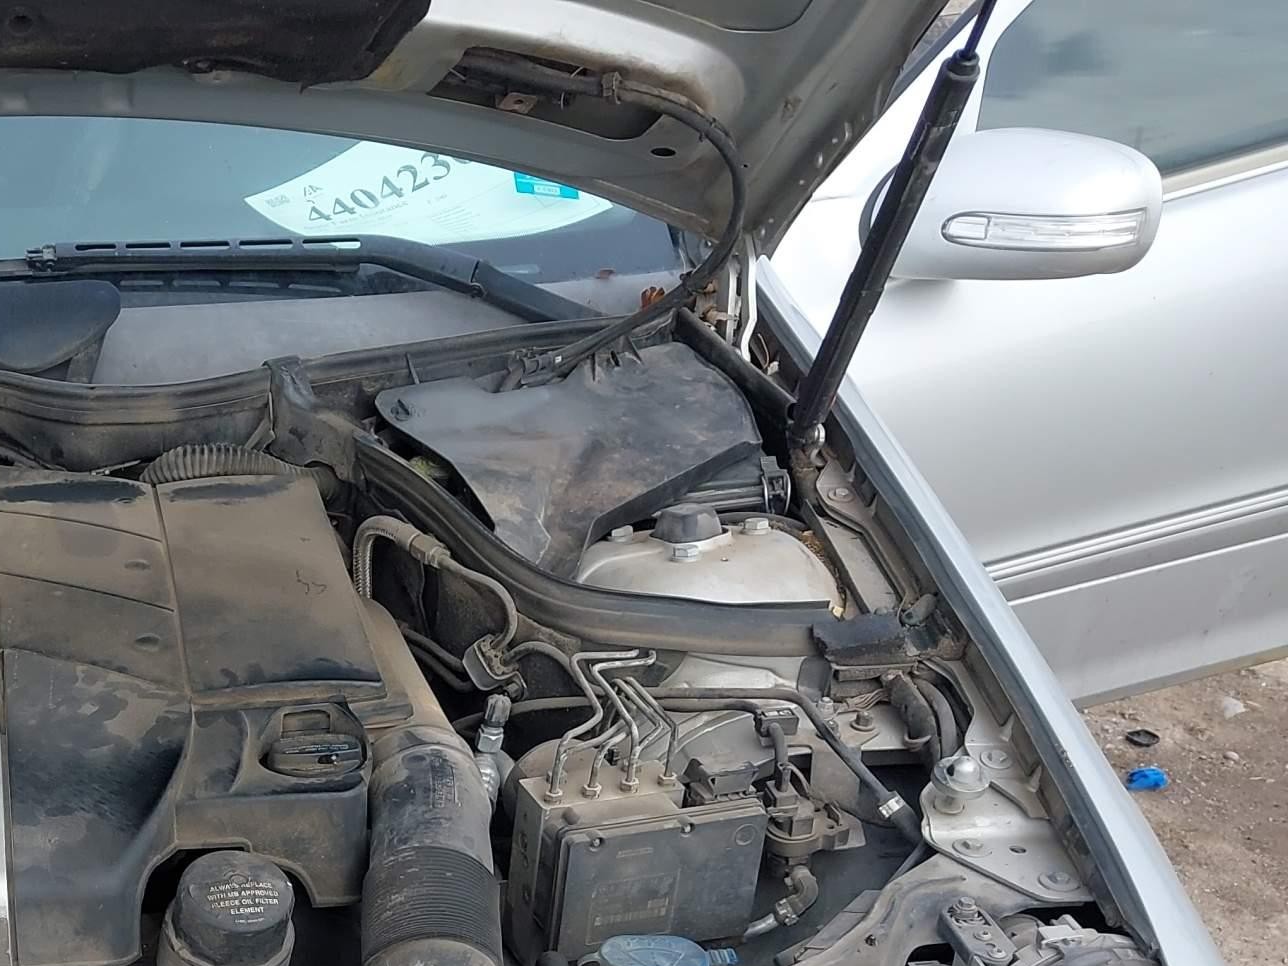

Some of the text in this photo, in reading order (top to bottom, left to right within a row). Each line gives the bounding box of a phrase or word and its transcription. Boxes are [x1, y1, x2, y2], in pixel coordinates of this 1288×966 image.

[308, 150, 470, 222] 440423
[207, 893, 226, 901] WITH
[212, 899, 240, 908] FLEECE
[230, 906, 264, 915] ELEMENT
